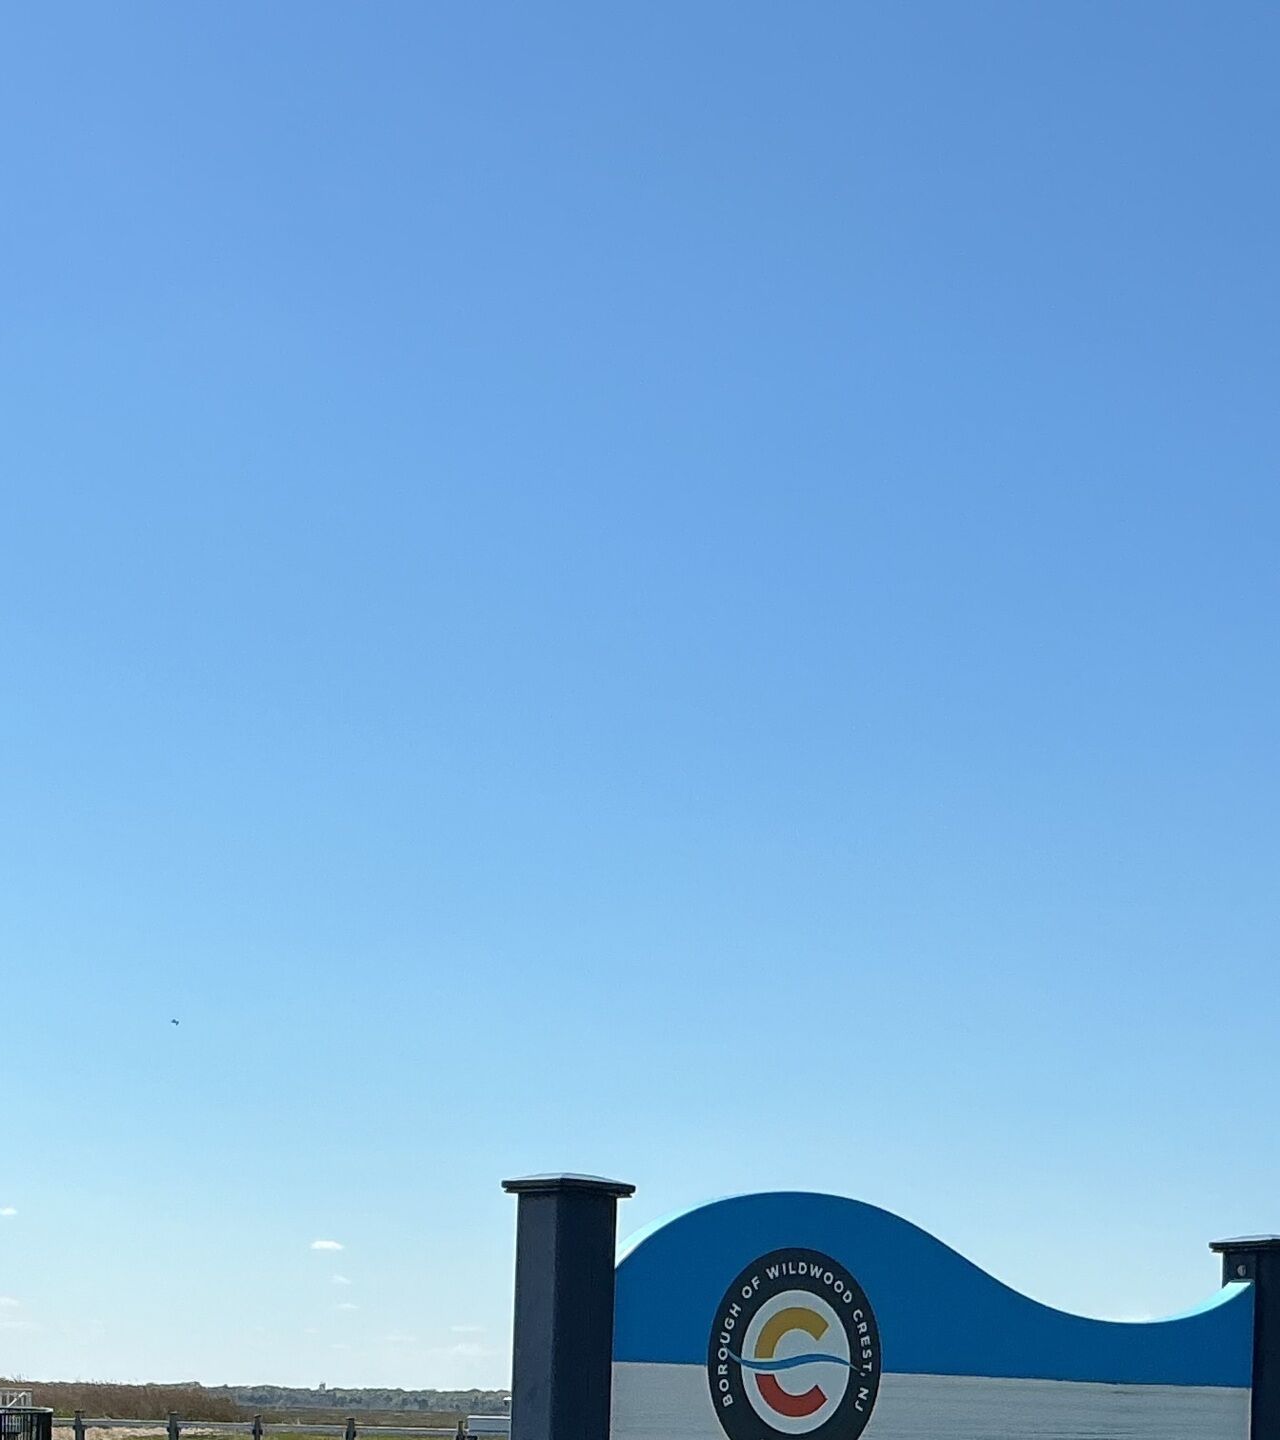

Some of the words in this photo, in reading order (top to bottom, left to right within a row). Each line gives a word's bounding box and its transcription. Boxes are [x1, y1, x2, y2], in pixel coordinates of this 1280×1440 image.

[741, 1275, 761, 1299] OF
[766, 1262, 853, 1304] WILDWOOD
[717, 1302, 742, 1407] BOROUGH
[852, 1308, 872, 1377] CREST,
[854, 1386, 870, 1412] NJ
